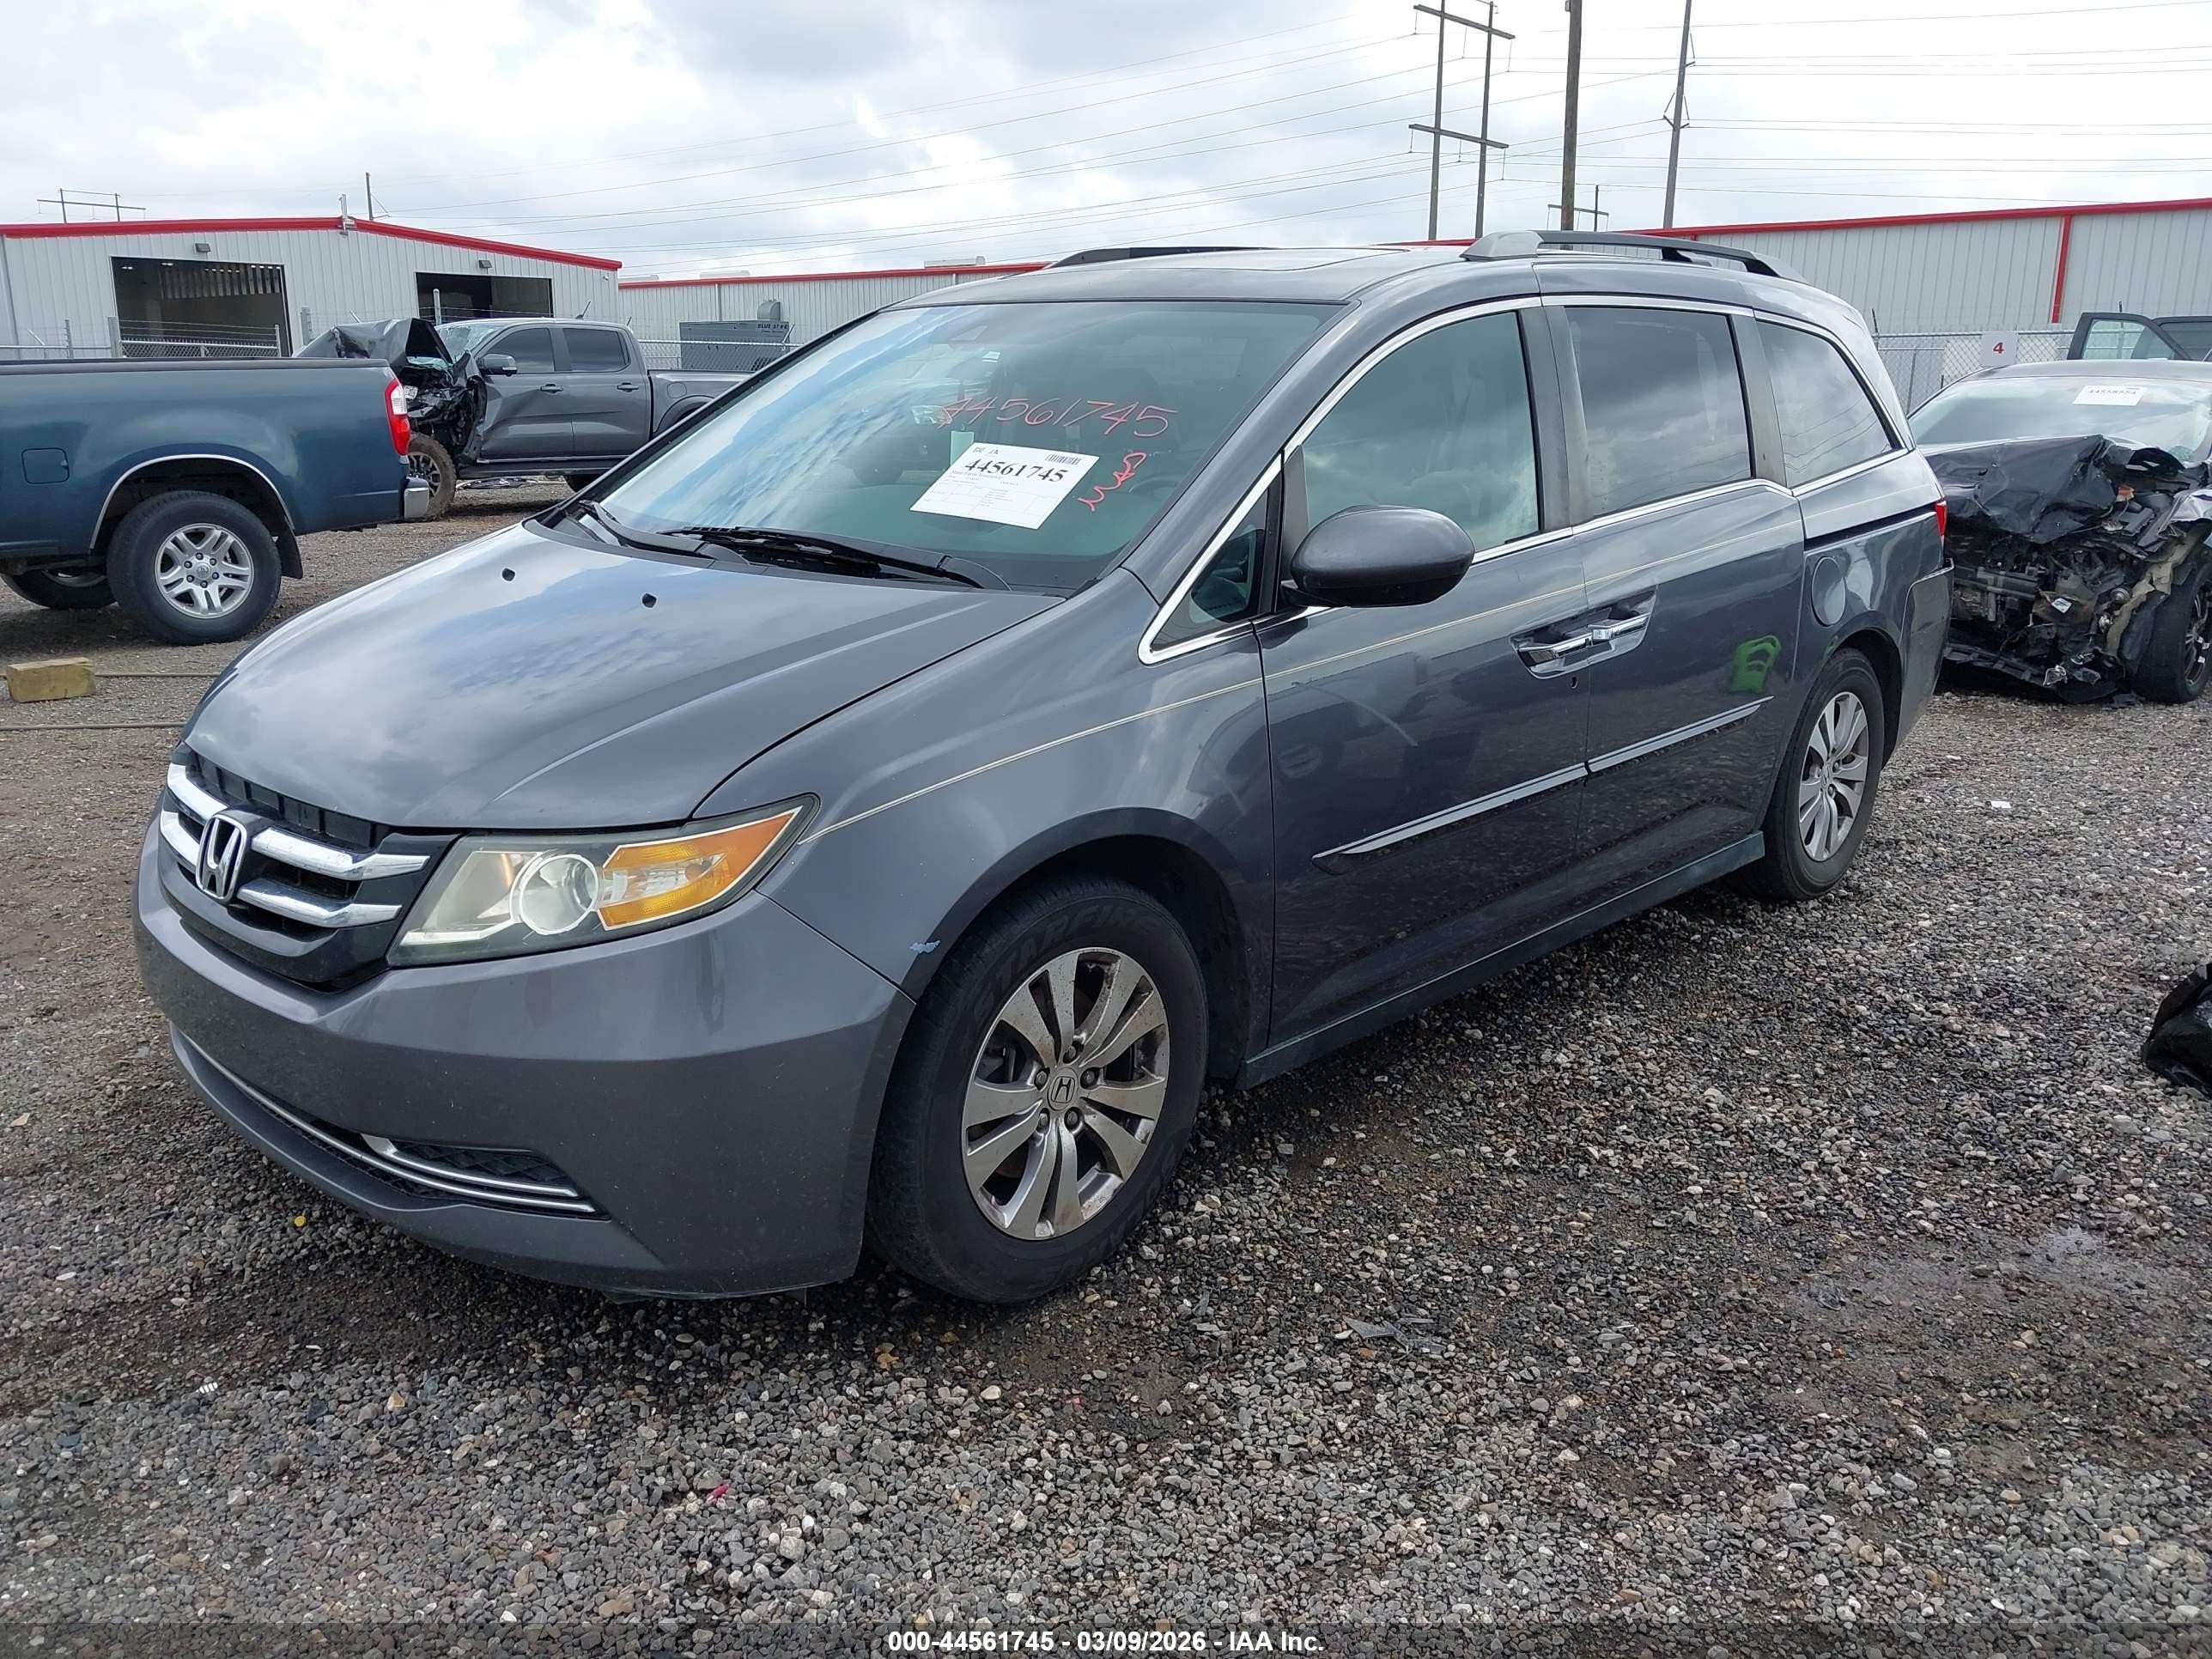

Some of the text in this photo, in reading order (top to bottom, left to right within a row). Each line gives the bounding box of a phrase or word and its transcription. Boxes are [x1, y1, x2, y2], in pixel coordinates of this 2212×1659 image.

[1992, 342, 2004, 354] 4
[938, 397, 1179, 437] 44561745
[964, 459, 1070, 483] 44561745
